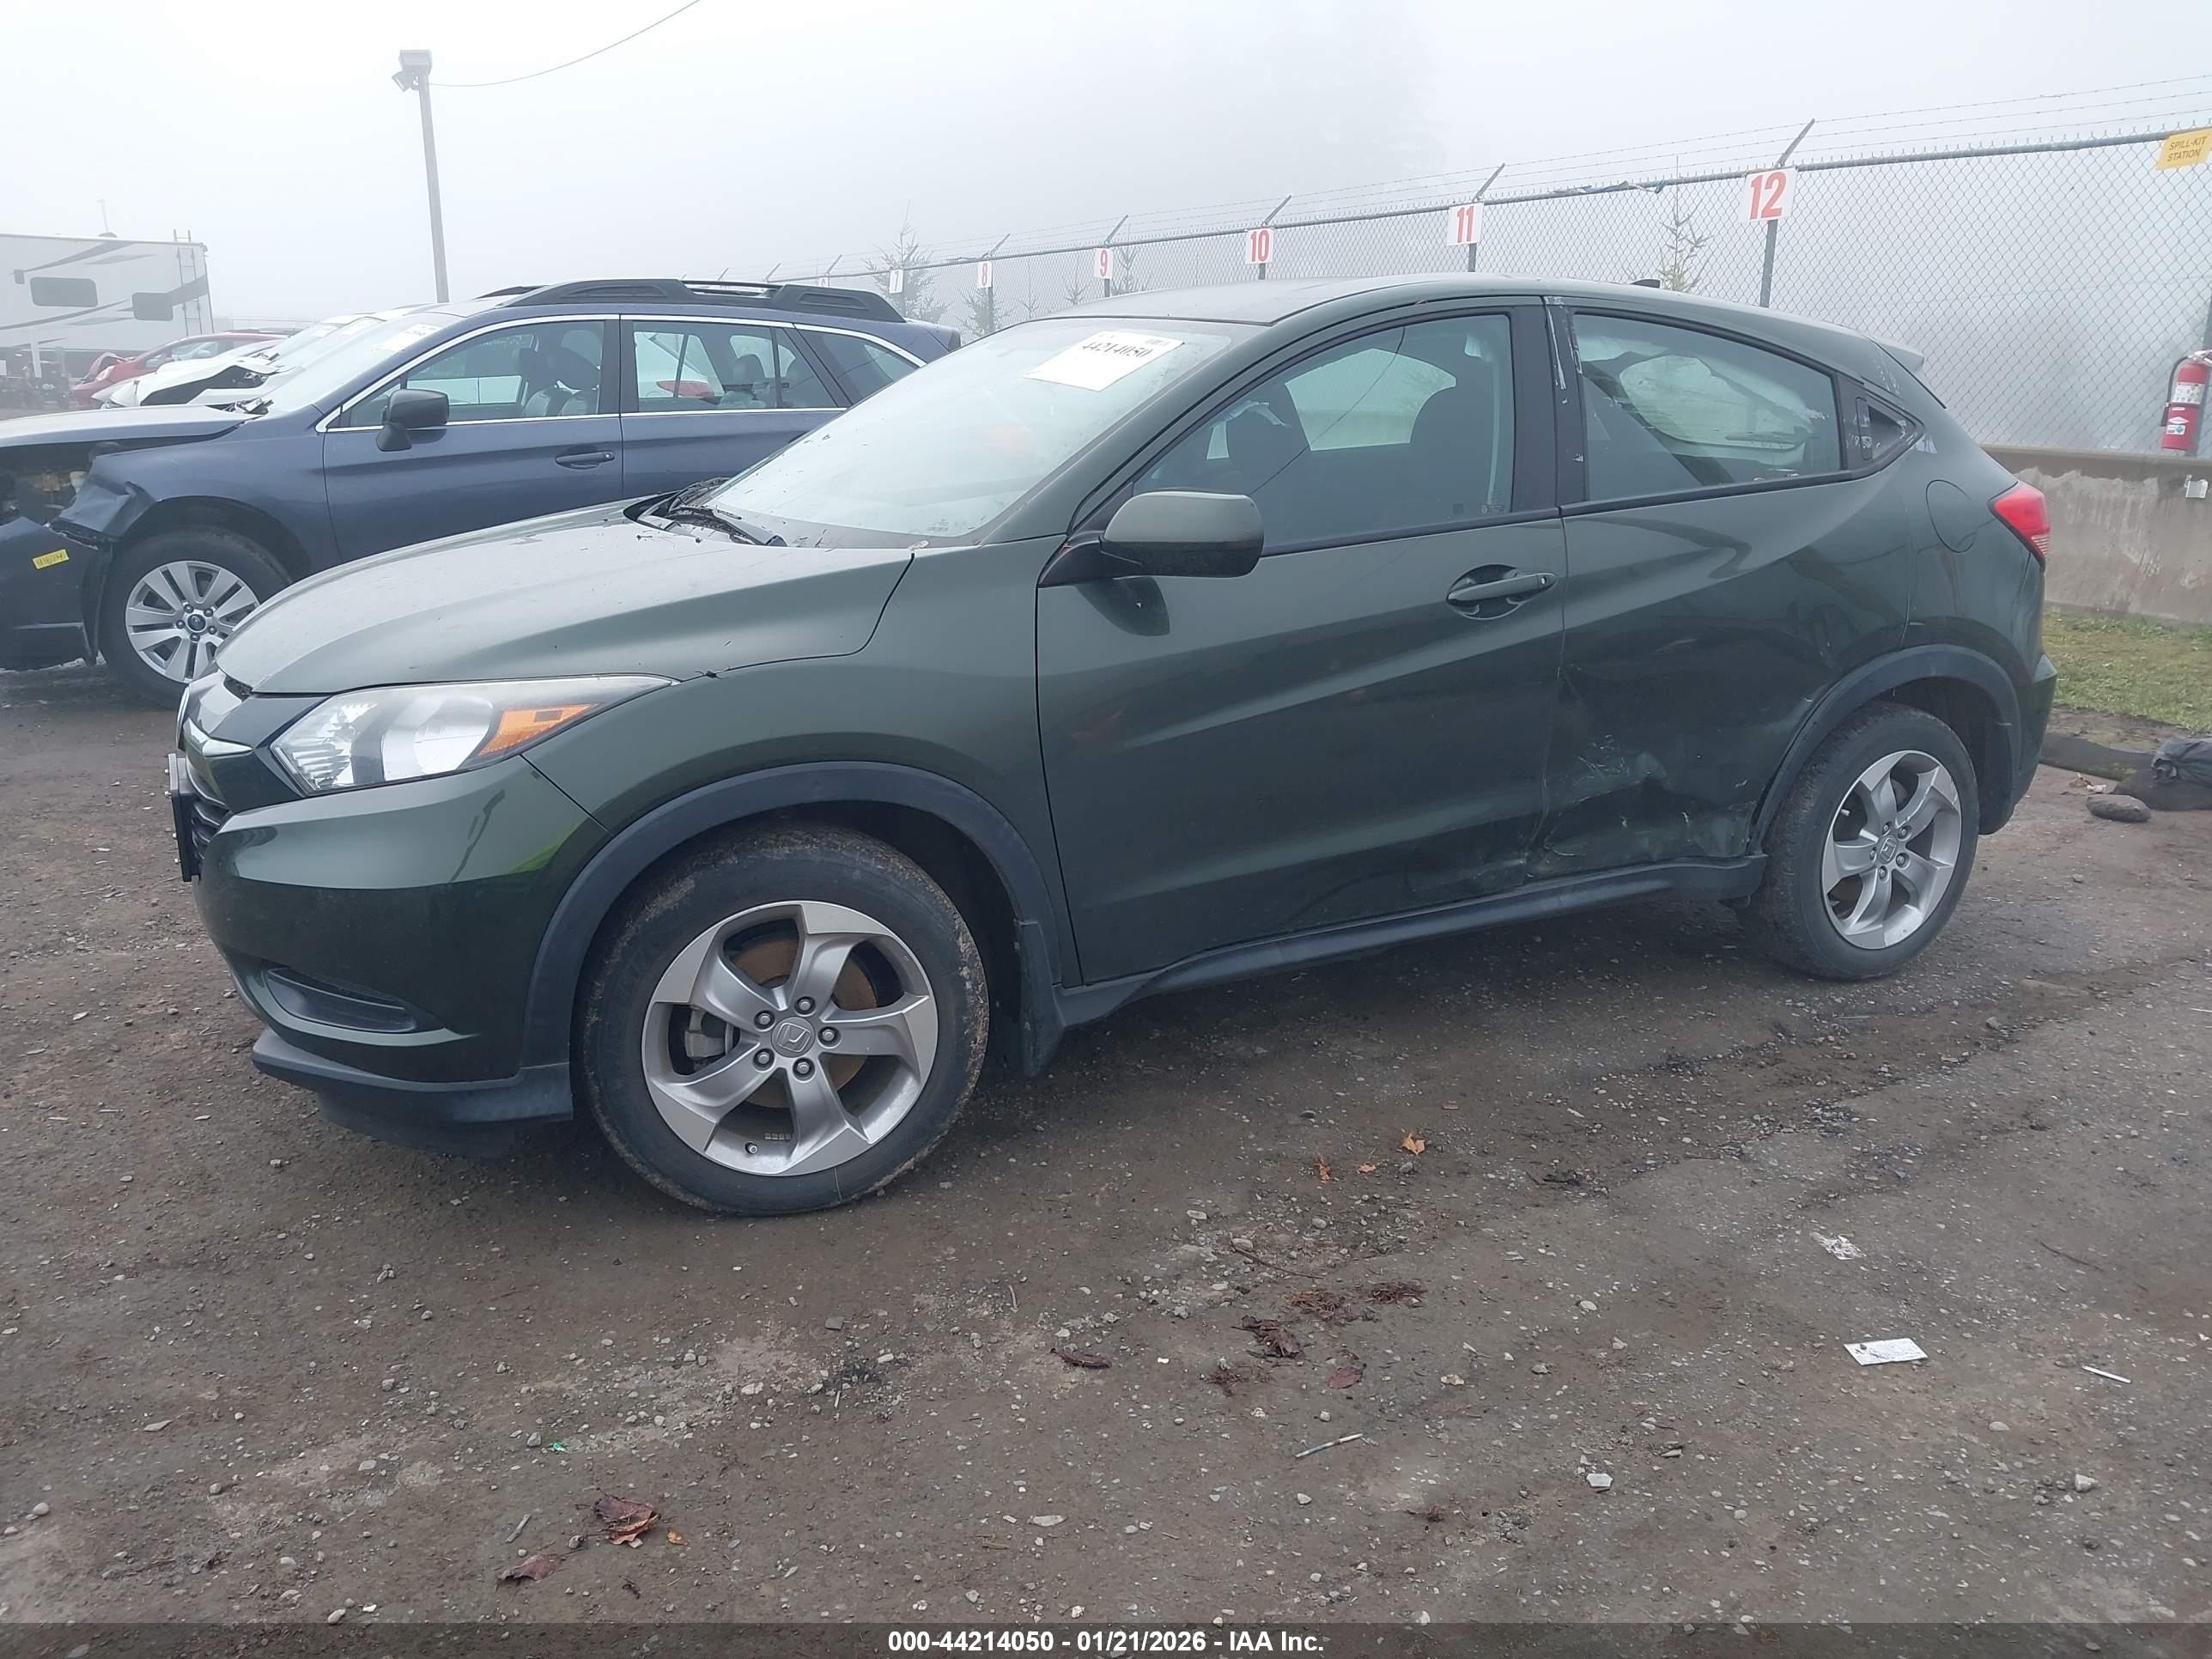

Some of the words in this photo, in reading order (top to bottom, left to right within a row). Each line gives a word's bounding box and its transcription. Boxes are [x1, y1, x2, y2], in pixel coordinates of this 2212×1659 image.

[2166, 148, 2202, 161] STATION
[1750, 172, 1787, 220] 12
[1456, 206, 1474, 243] 11
[1250, 230, 1270, 262] 10
[981, 262, 988, 286] 8
[1100, 250, 1108, 276] 9
